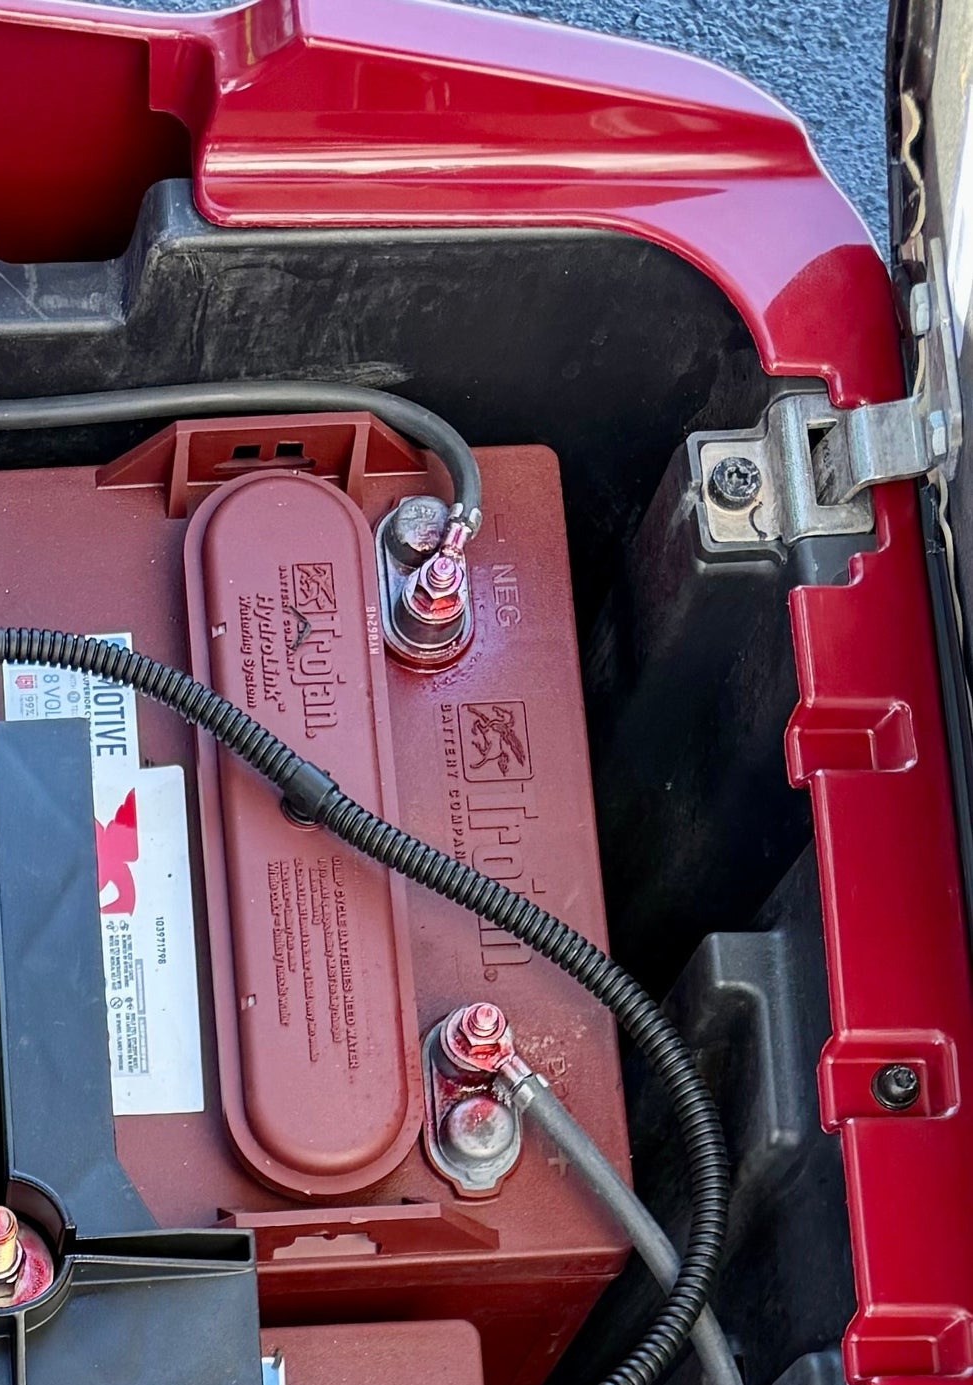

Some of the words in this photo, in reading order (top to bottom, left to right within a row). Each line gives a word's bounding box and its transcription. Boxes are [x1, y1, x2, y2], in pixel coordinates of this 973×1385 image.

[492, 562, 521, 627] NEG
[239, 596, 253, 654] Watering
[43, 674, 60, 683] 8
[242, 659, 257, 708] System
[25, 696, 35, 716] 99%
[441, 704, 458, 779] BATTERY
[334, 889, 347, 928] CYCLE
[155, 916, 166, 964] 103971798
[337, 929, 354, 991] BATTERIES
[344, 993, 356, 1024] NEED
[347, 1027, 360, 1069] WATER
